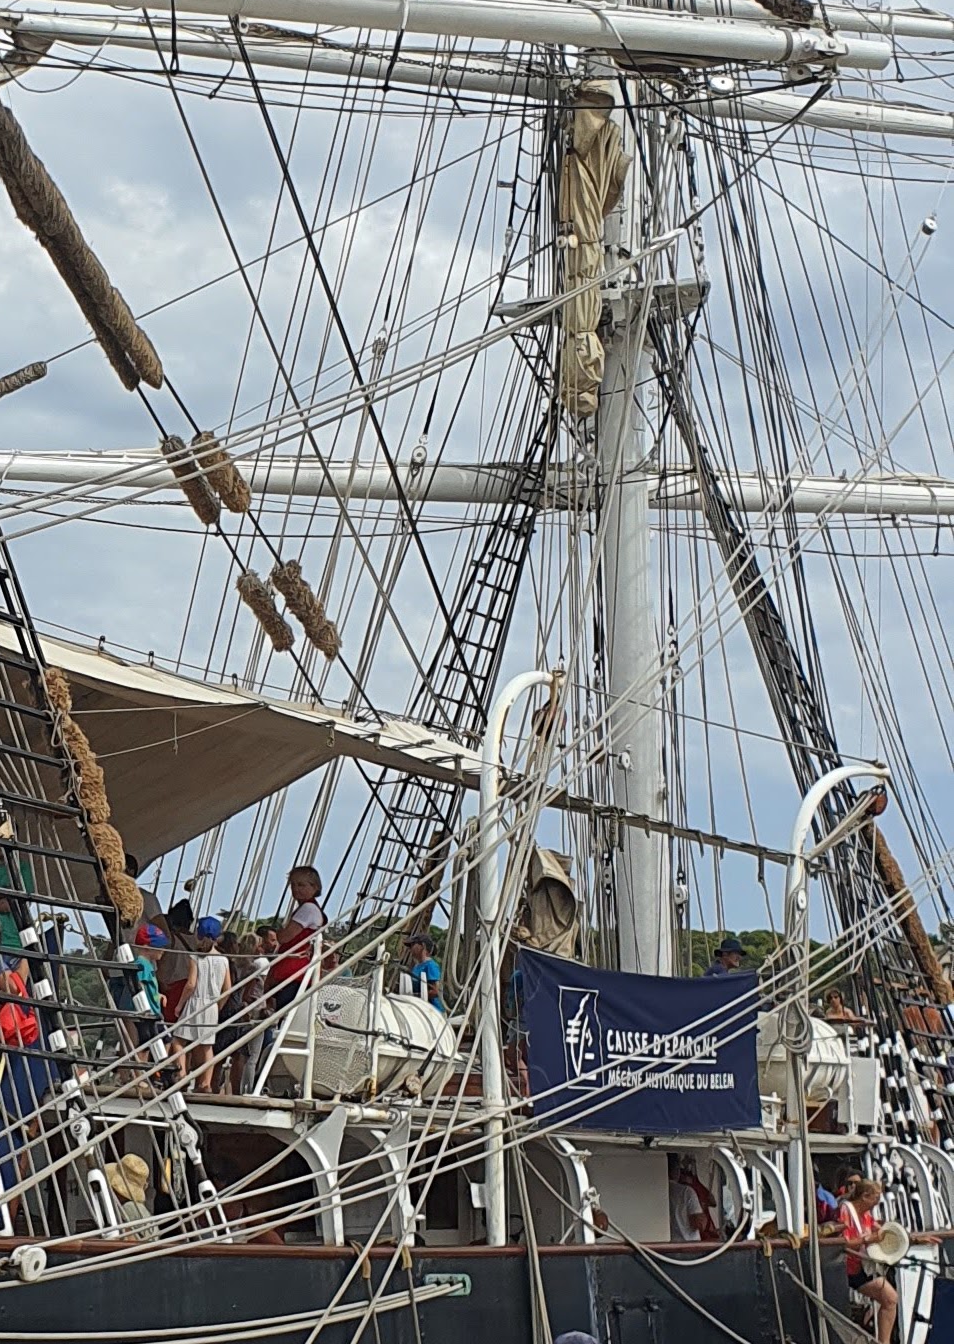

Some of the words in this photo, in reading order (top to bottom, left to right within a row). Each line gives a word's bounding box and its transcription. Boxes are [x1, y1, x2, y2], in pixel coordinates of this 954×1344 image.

[607, 1029, 648, 1055] CAISSE
[645, 1071, 694, 1093] HISTORIQUE
[696, 1073, 708, 1089] DU
[710, 1073, 734, 1089] BELEM
